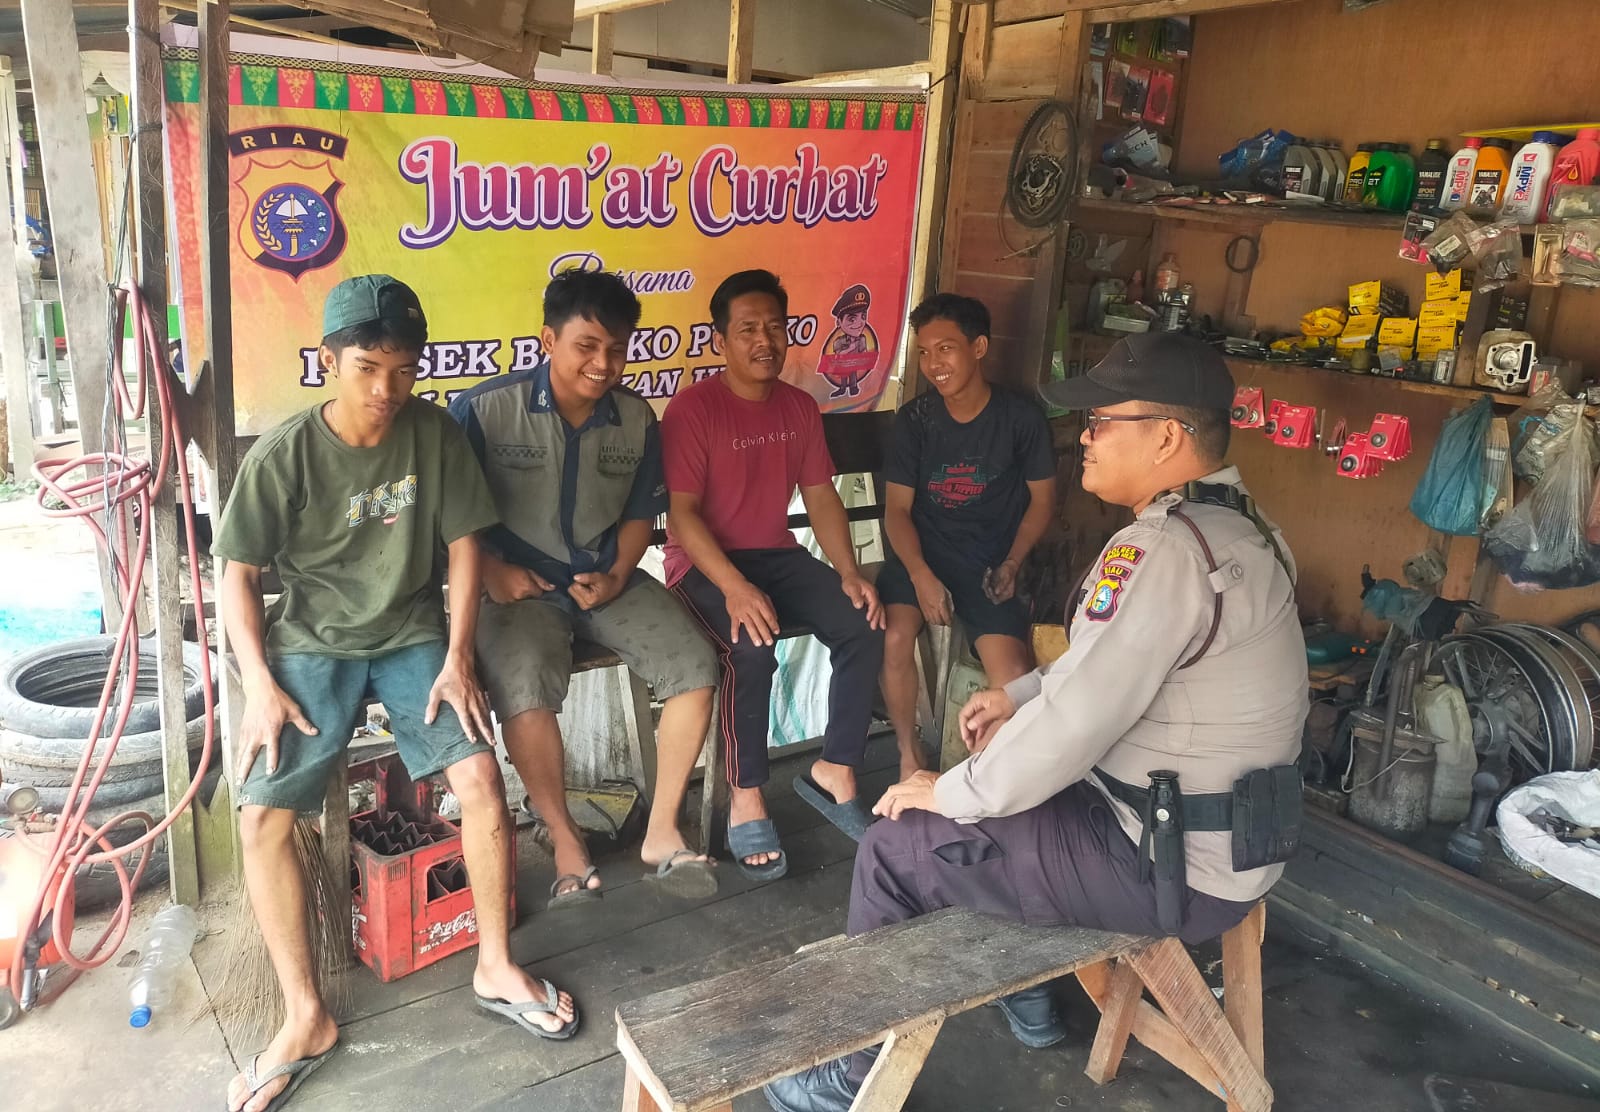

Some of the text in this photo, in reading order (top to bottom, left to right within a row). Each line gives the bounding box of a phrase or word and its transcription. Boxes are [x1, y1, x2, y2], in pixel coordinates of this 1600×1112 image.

[240, 132, 335, 151] RIAU
[399, 135, 888, 250] Jum'at Curhat
[732, 429, 798, 450] Calvin Klein
